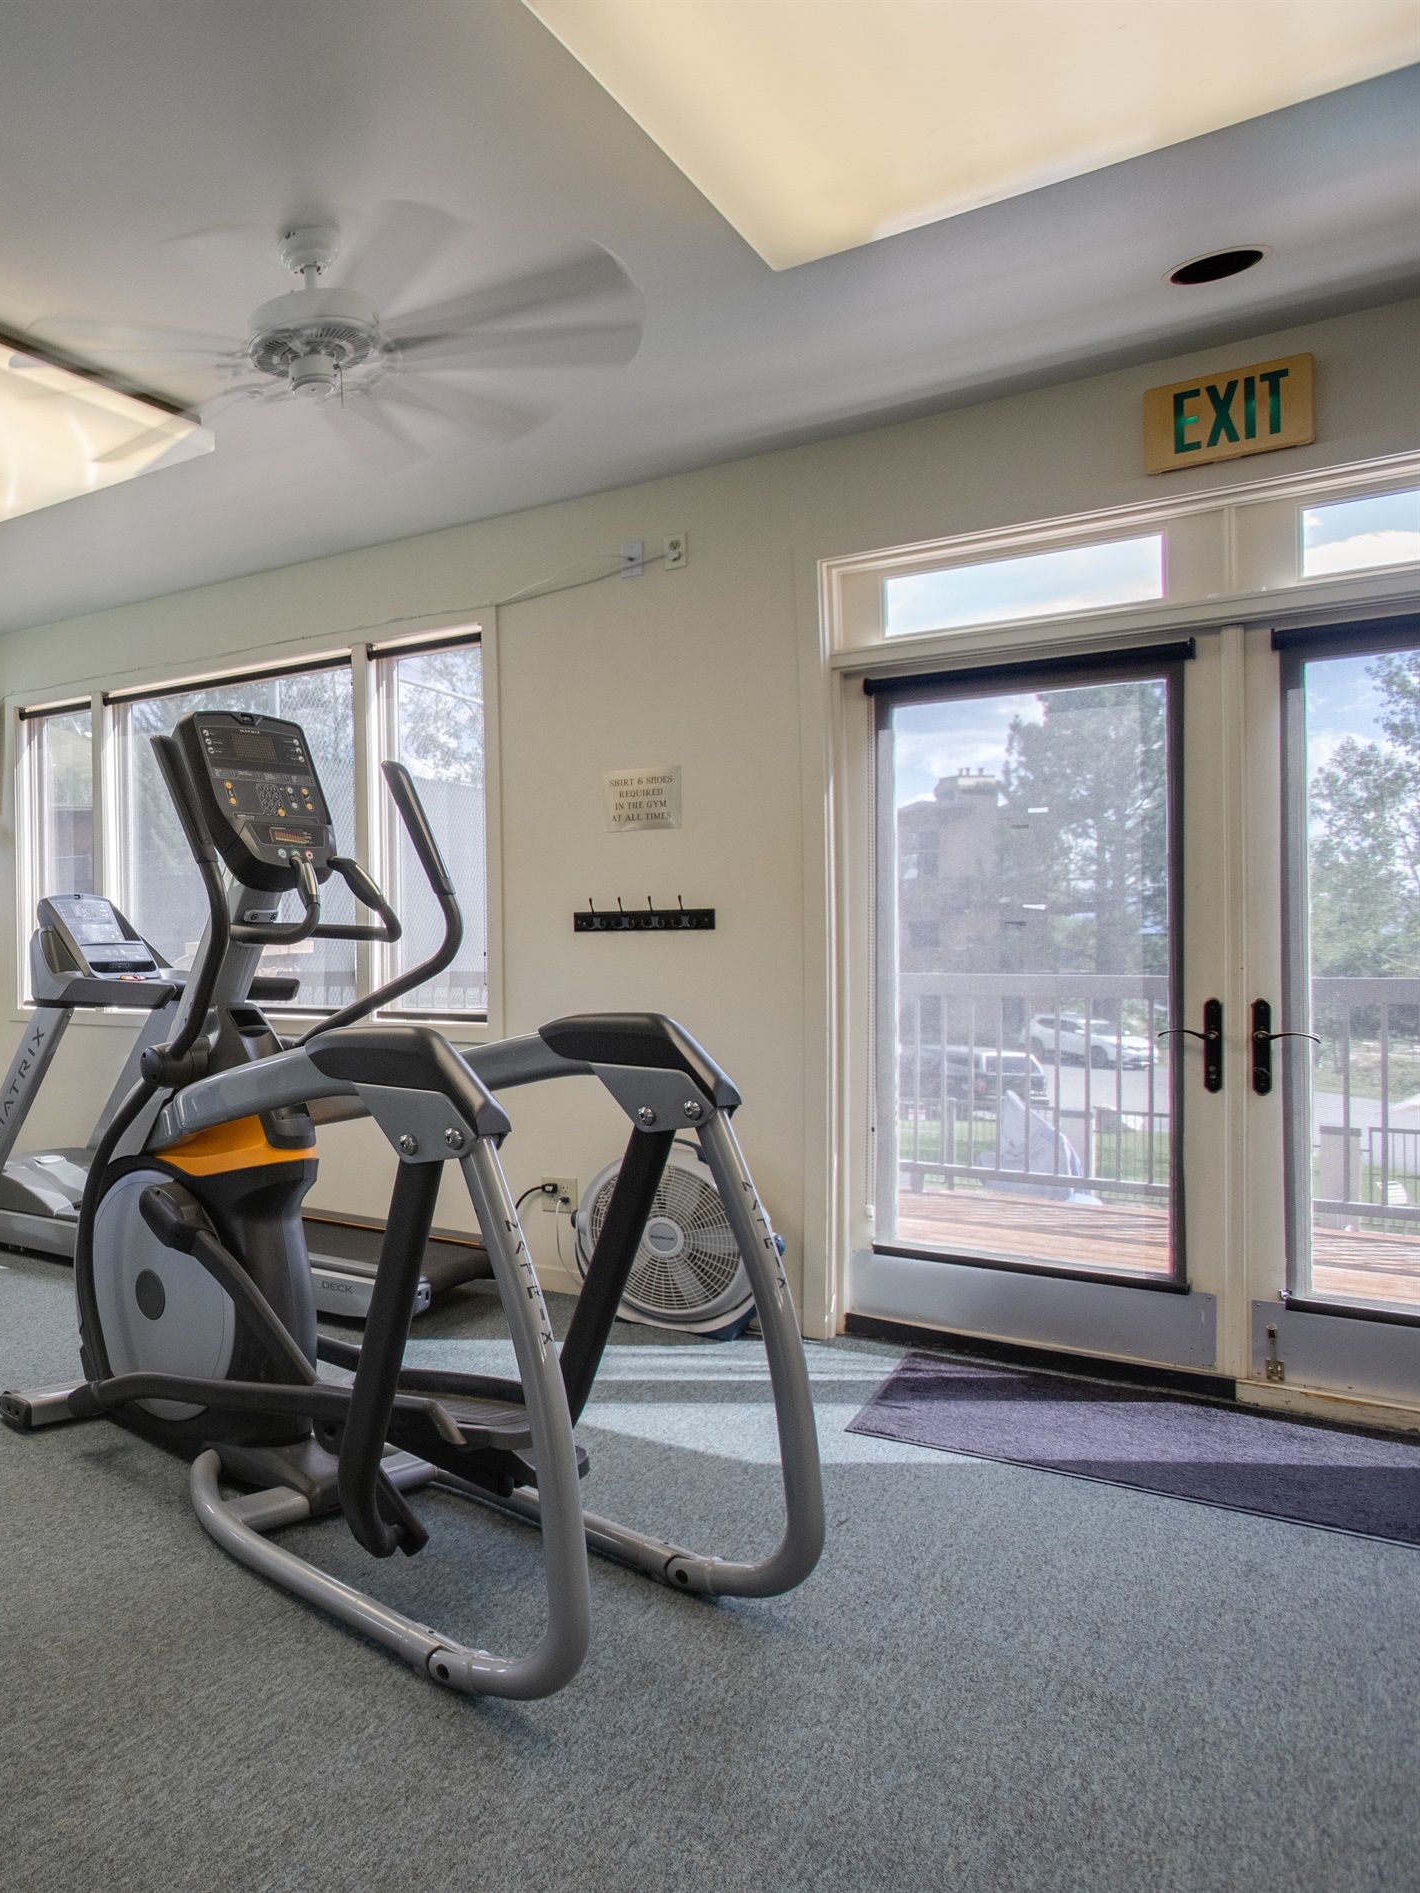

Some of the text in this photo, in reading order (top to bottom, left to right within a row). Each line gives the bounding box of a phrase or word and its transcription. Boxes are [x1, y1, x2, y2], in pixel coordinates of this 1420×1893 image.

[1173, 368, 1289, 455] EXIT
[609, 778, 634, 787] SHIRT
[645, 775, 673, 785] SHOES
[619, 788, 663, 798] REQUIRED
[615, 800, 667, 810] IN THE GYM
[611, 811, 672, 822] AT ALL TIMES
[321, 1281, 353, 1294] DECK
[505, 1219, 555, 1345] MATRIX
